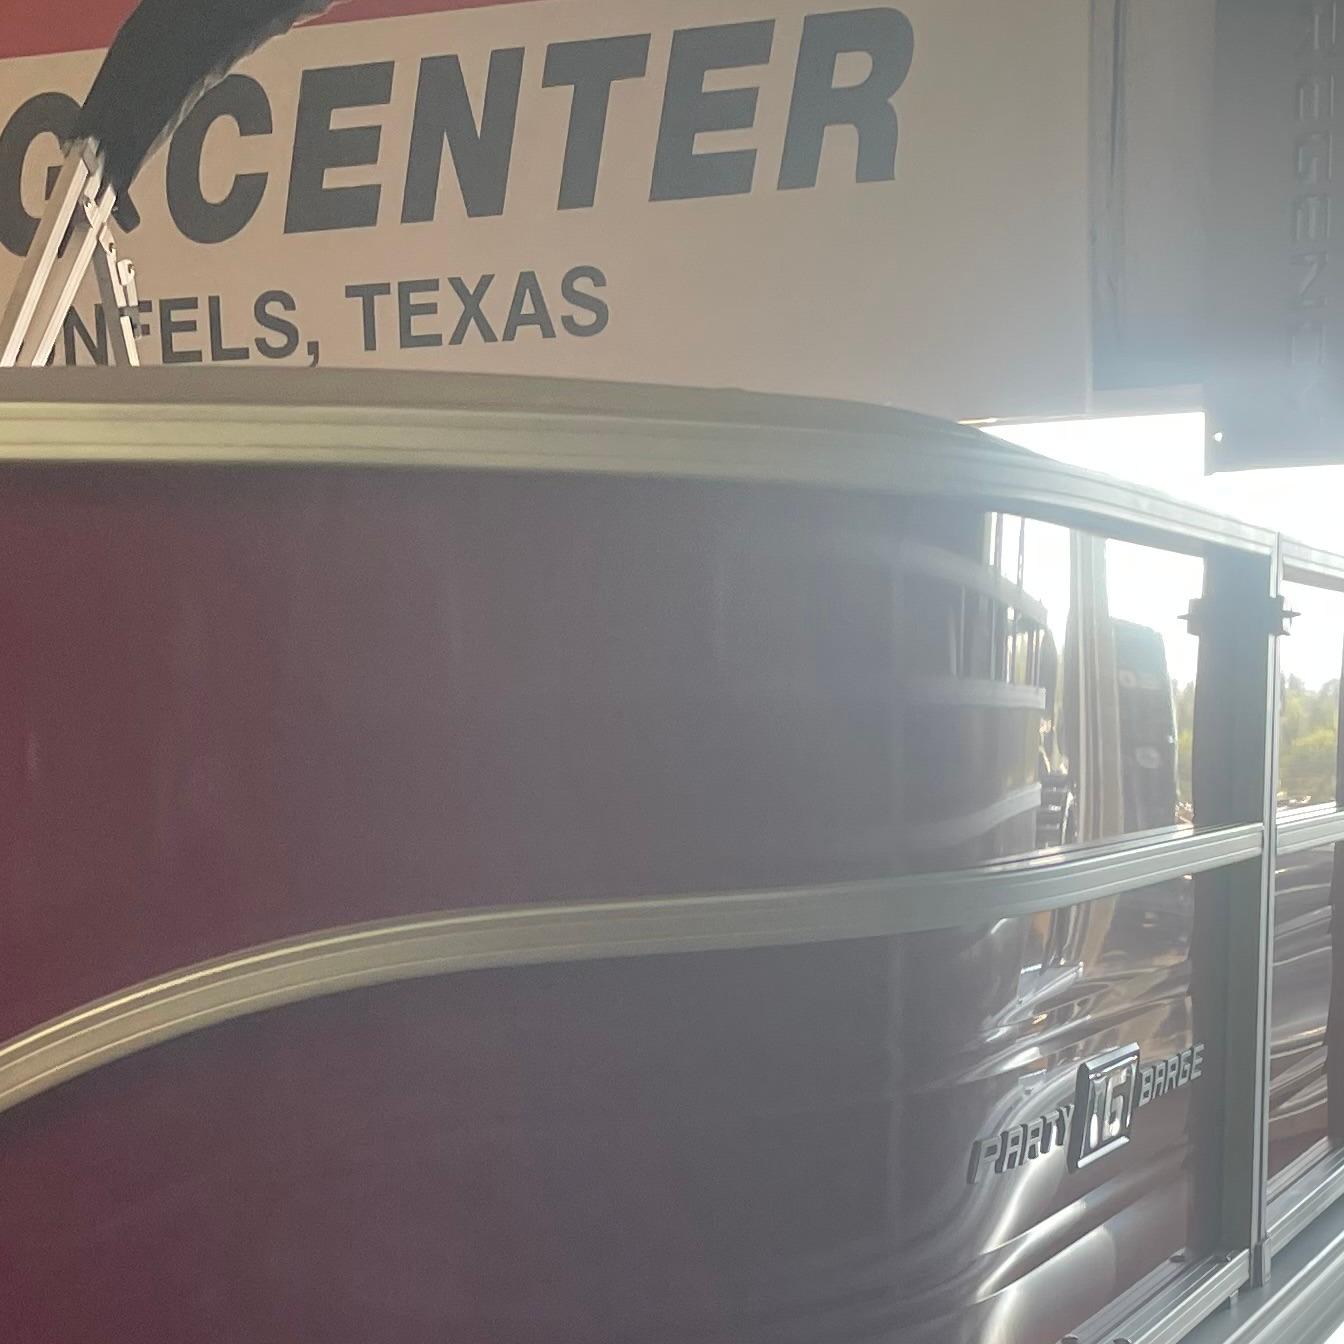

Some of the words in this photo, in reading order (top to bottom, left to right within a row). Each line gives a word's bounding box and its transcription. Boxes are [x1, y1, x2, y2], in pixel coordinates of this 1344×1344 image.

[164, 6, 916, 245] CENTER
[345, 265, 610, 352] TEXAS
[966, 1103, 1075, 1184] PARTY
[1138, 1043, 1206, 1107] BARGE
